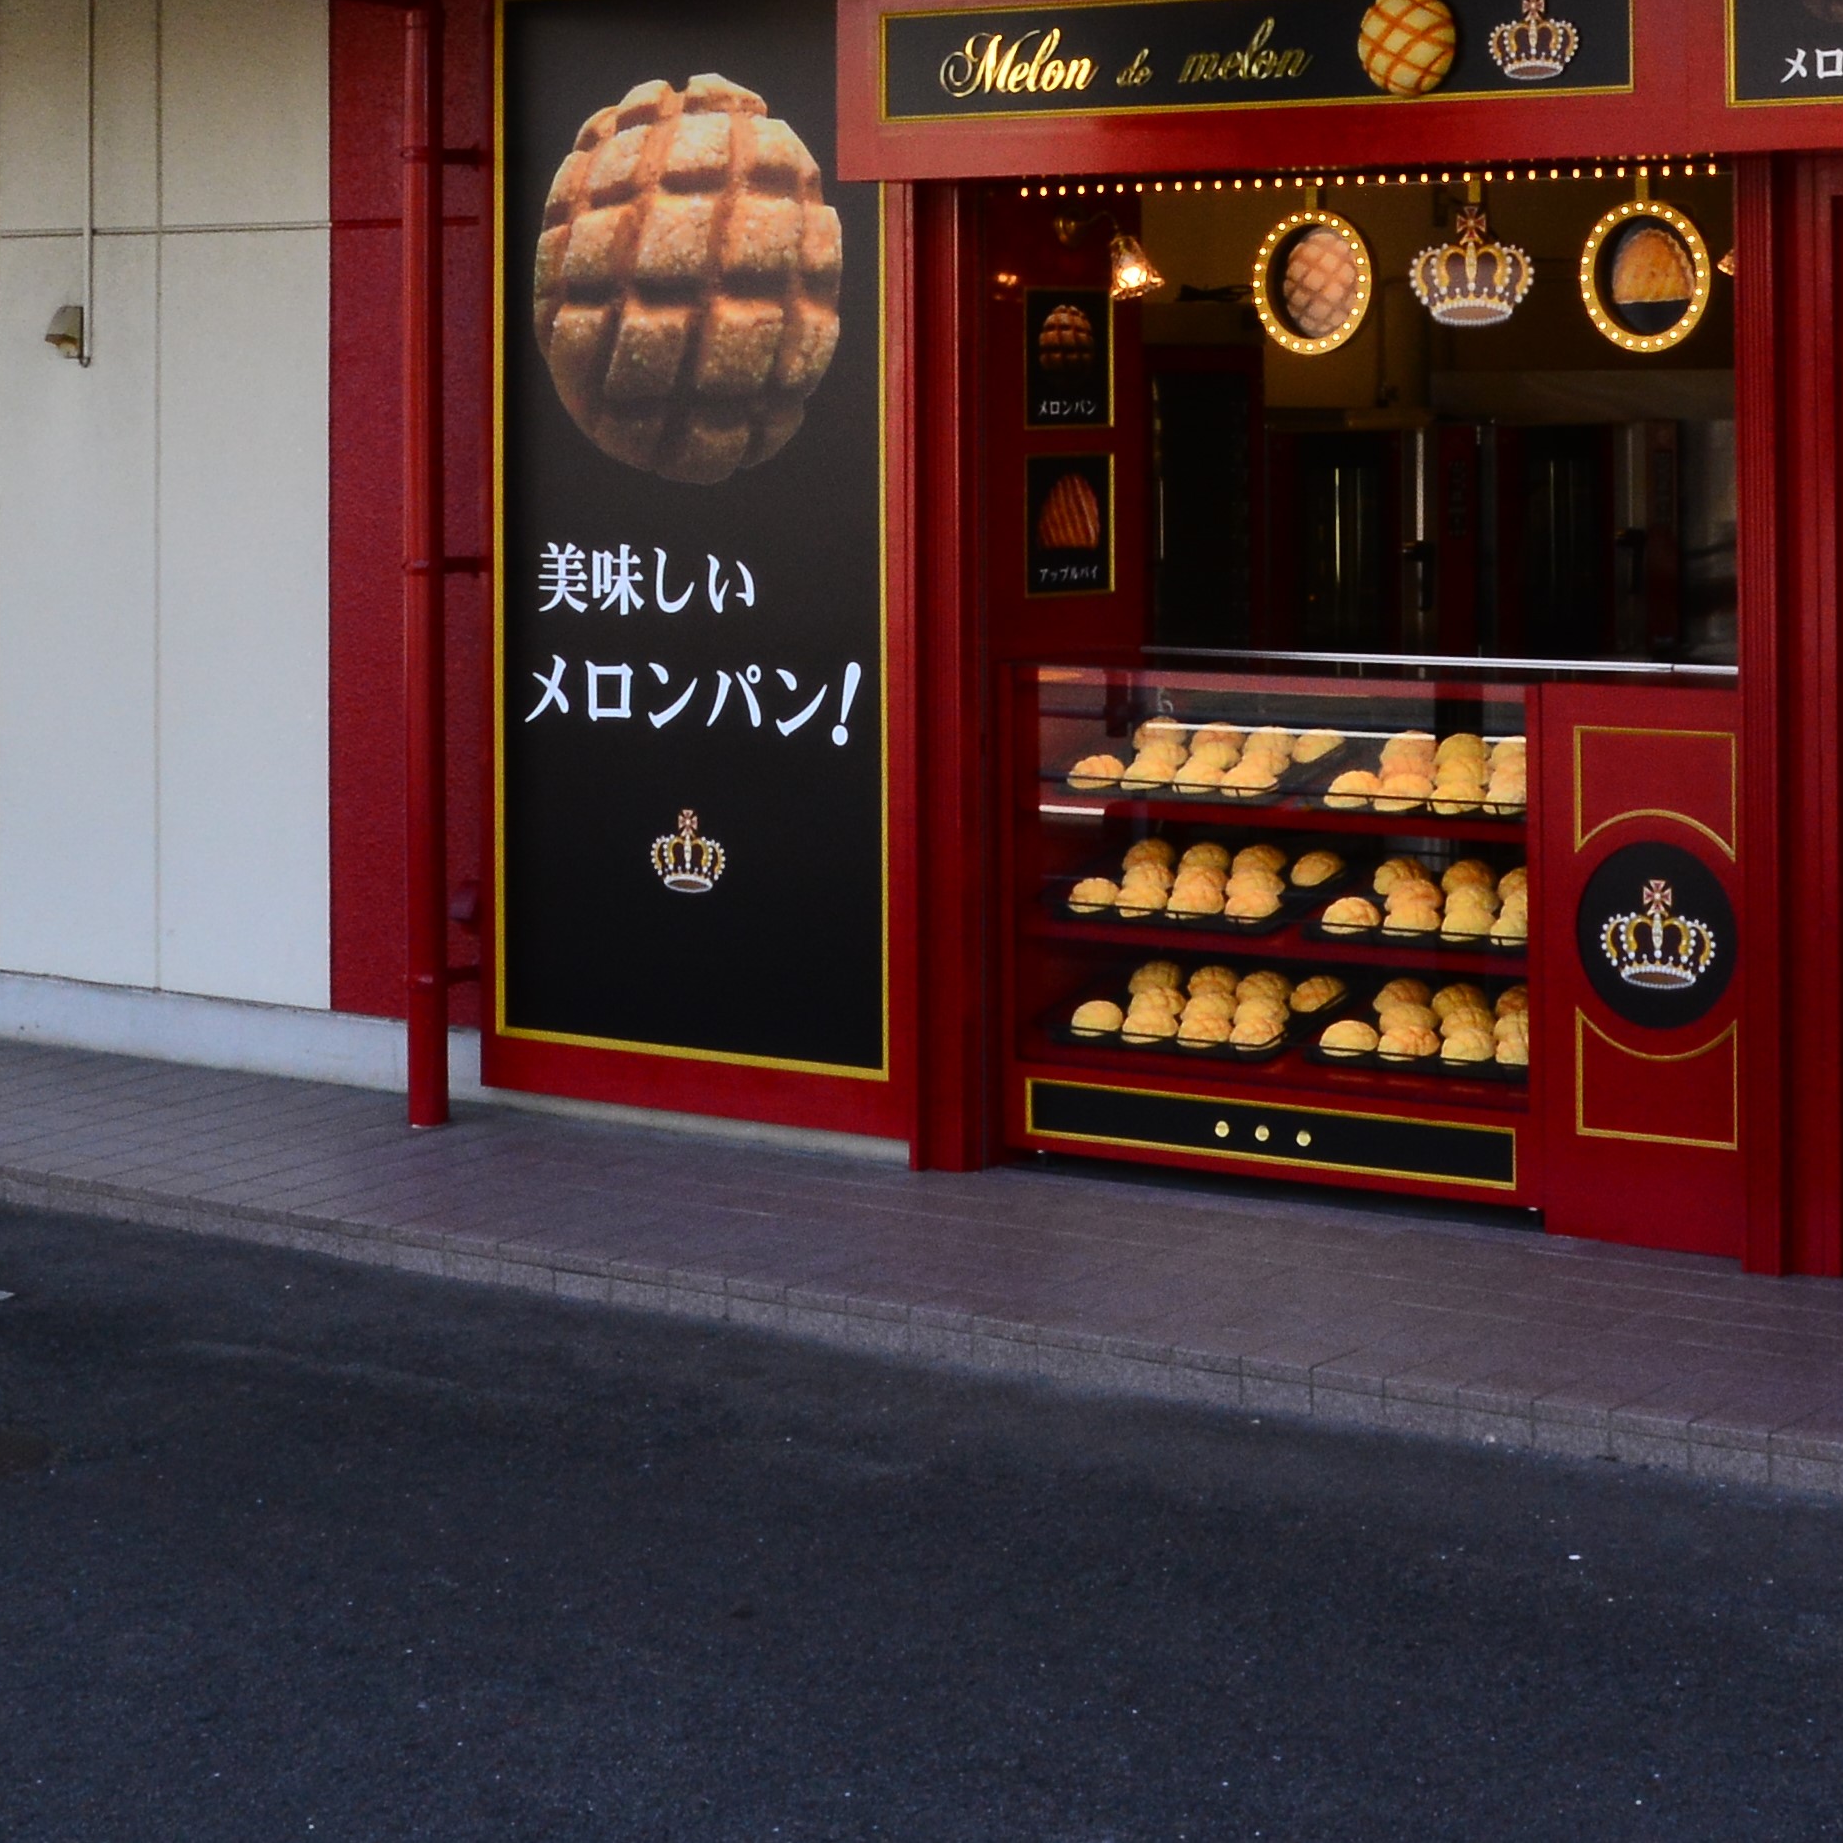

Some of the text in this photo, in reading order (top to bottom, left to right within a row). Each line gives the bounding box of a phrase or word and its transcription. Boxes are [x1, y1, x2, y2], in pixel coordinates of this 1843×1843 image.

[939, 16, 1313, 98] Melon de melon
[537, 540, 756, 617] 美味しい
[523, 653, 863, 747] メロンパン!
